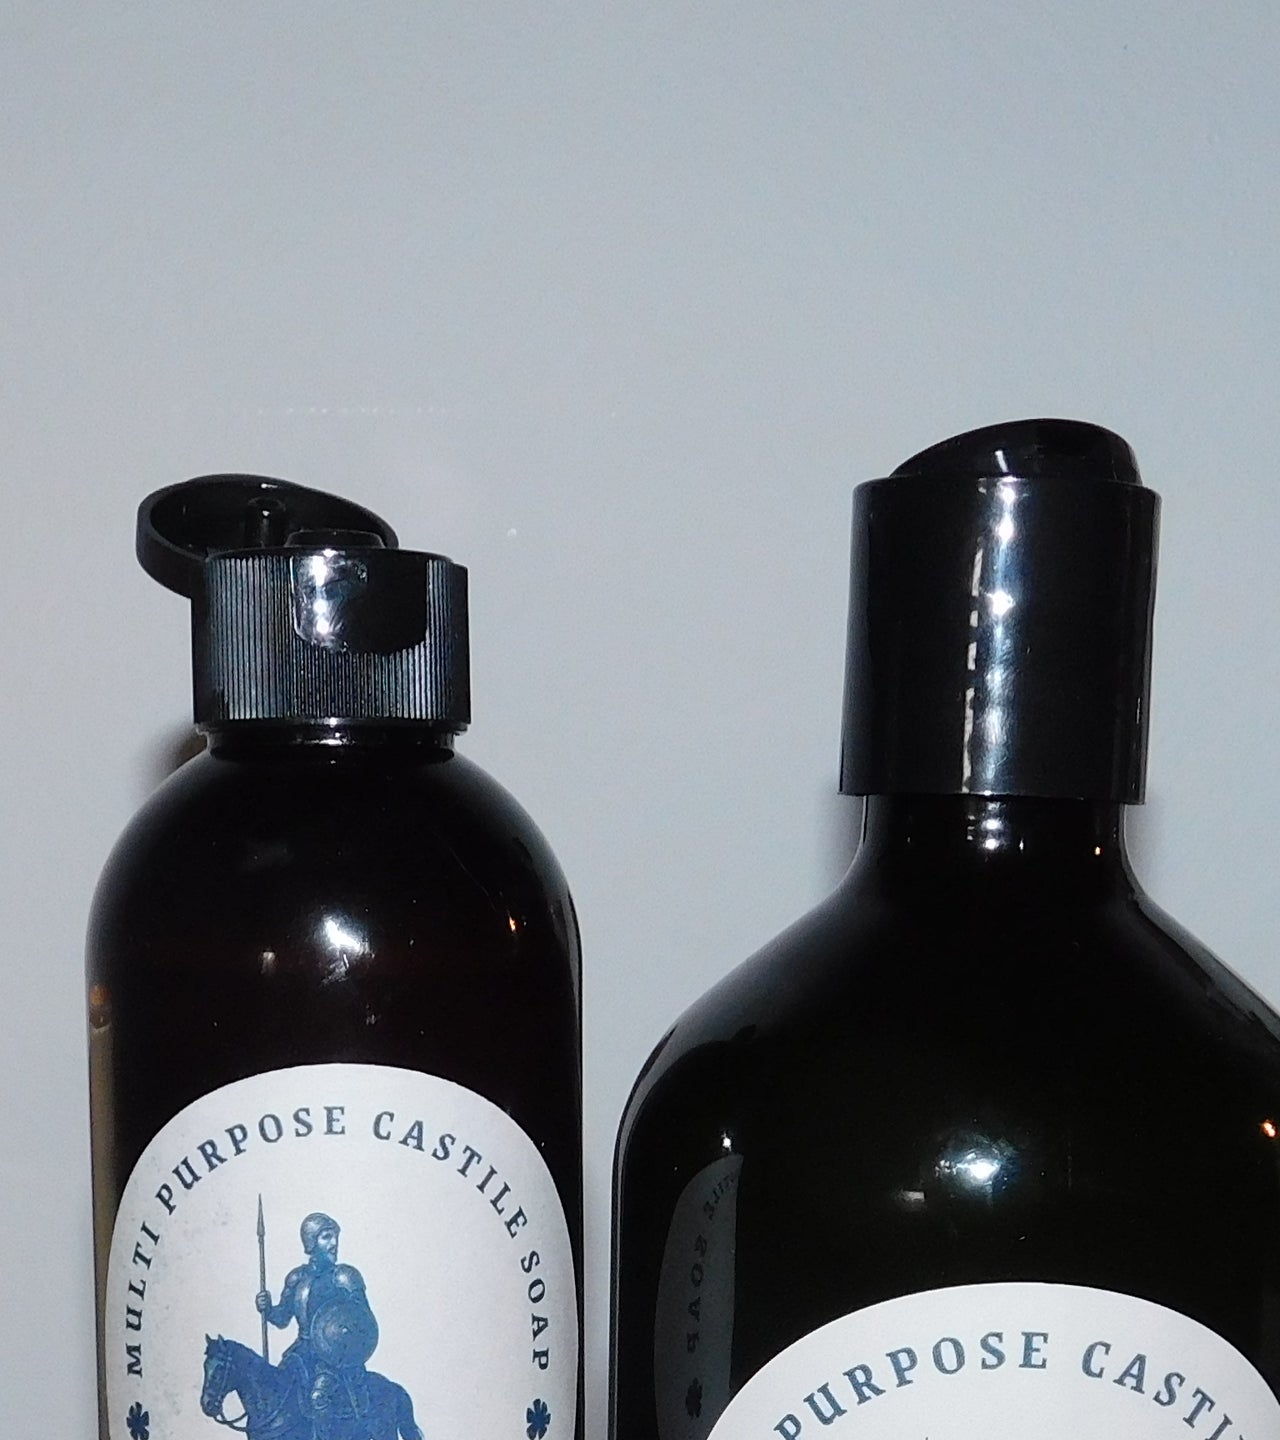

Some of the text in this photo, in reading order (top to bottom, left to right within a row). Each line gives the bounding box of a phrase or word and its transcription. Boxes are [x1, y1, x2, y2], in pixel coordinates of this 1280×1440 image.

[125, 1106, 550, 1379] MULTI PURPOSE CASTILE SOAP
